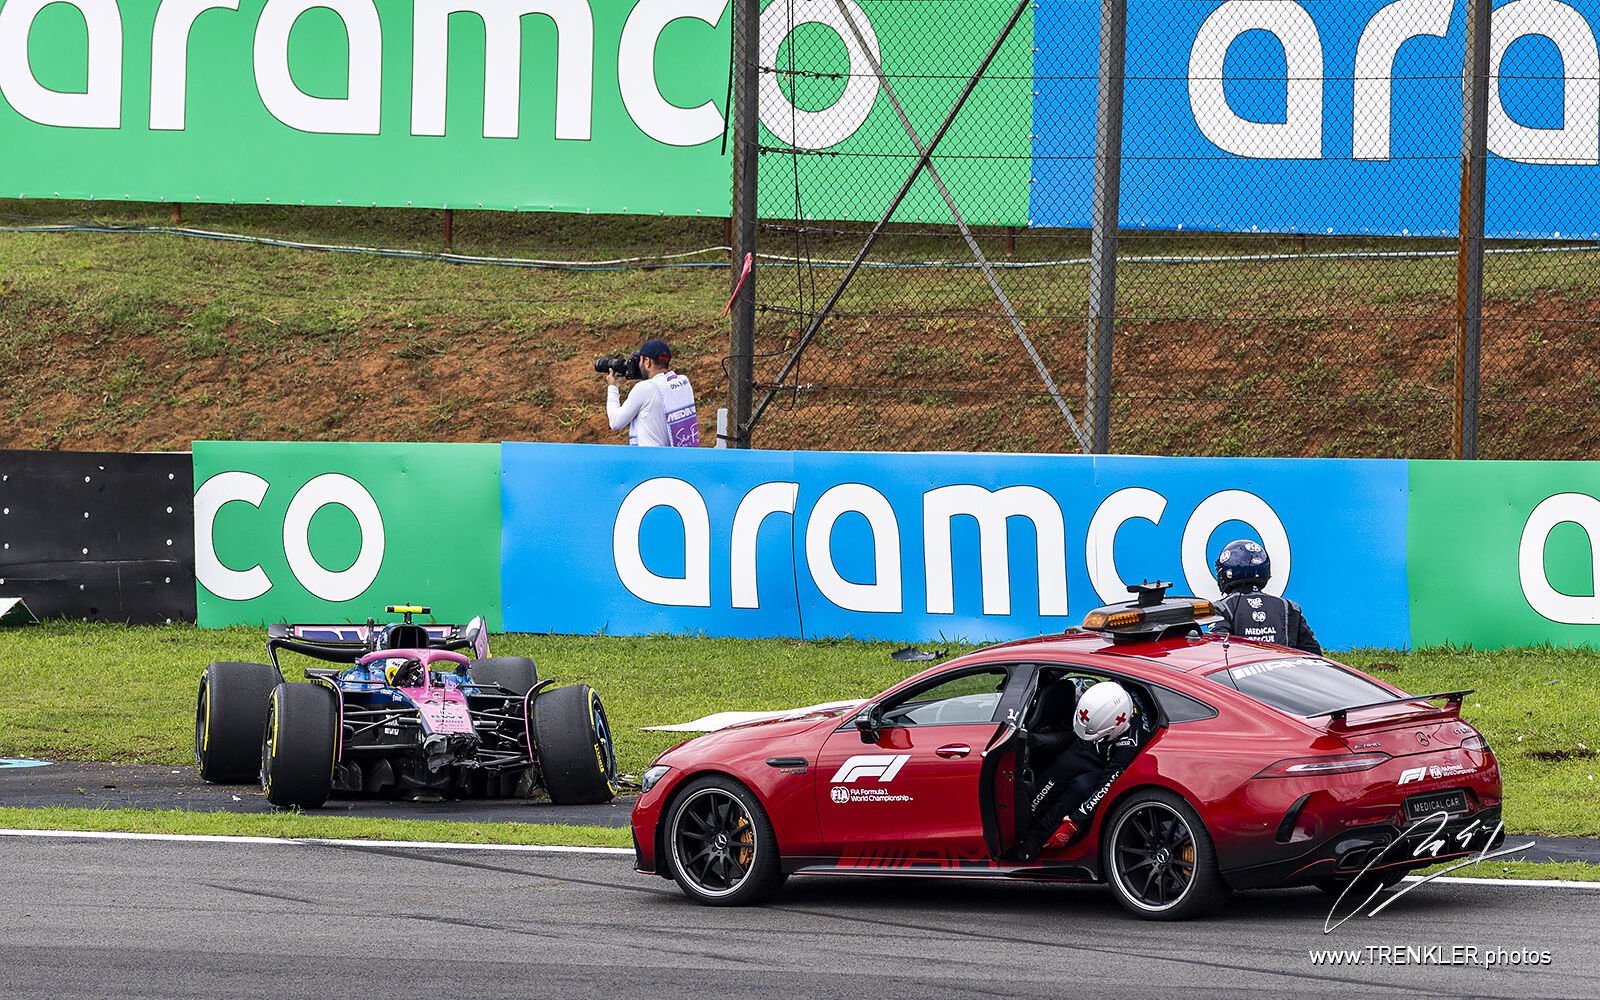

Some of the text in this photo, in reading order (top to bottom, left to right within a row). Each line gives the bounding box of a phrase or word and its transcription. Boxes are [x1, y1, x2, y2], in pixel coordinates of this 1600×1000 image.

[0, 0, 881, 150] aramco
[193, 471, 386, 603] co
[613, 477, 1292, 617] aramco
[1245, 626, 1277, 635] MEDICAL
[829, 754, 912, 783] F1
[1397, 766, 1428, 786] F1
[831, 787, 850, 803] FIA
[1413, 797, 1461, 812] MEDICAL CAR
